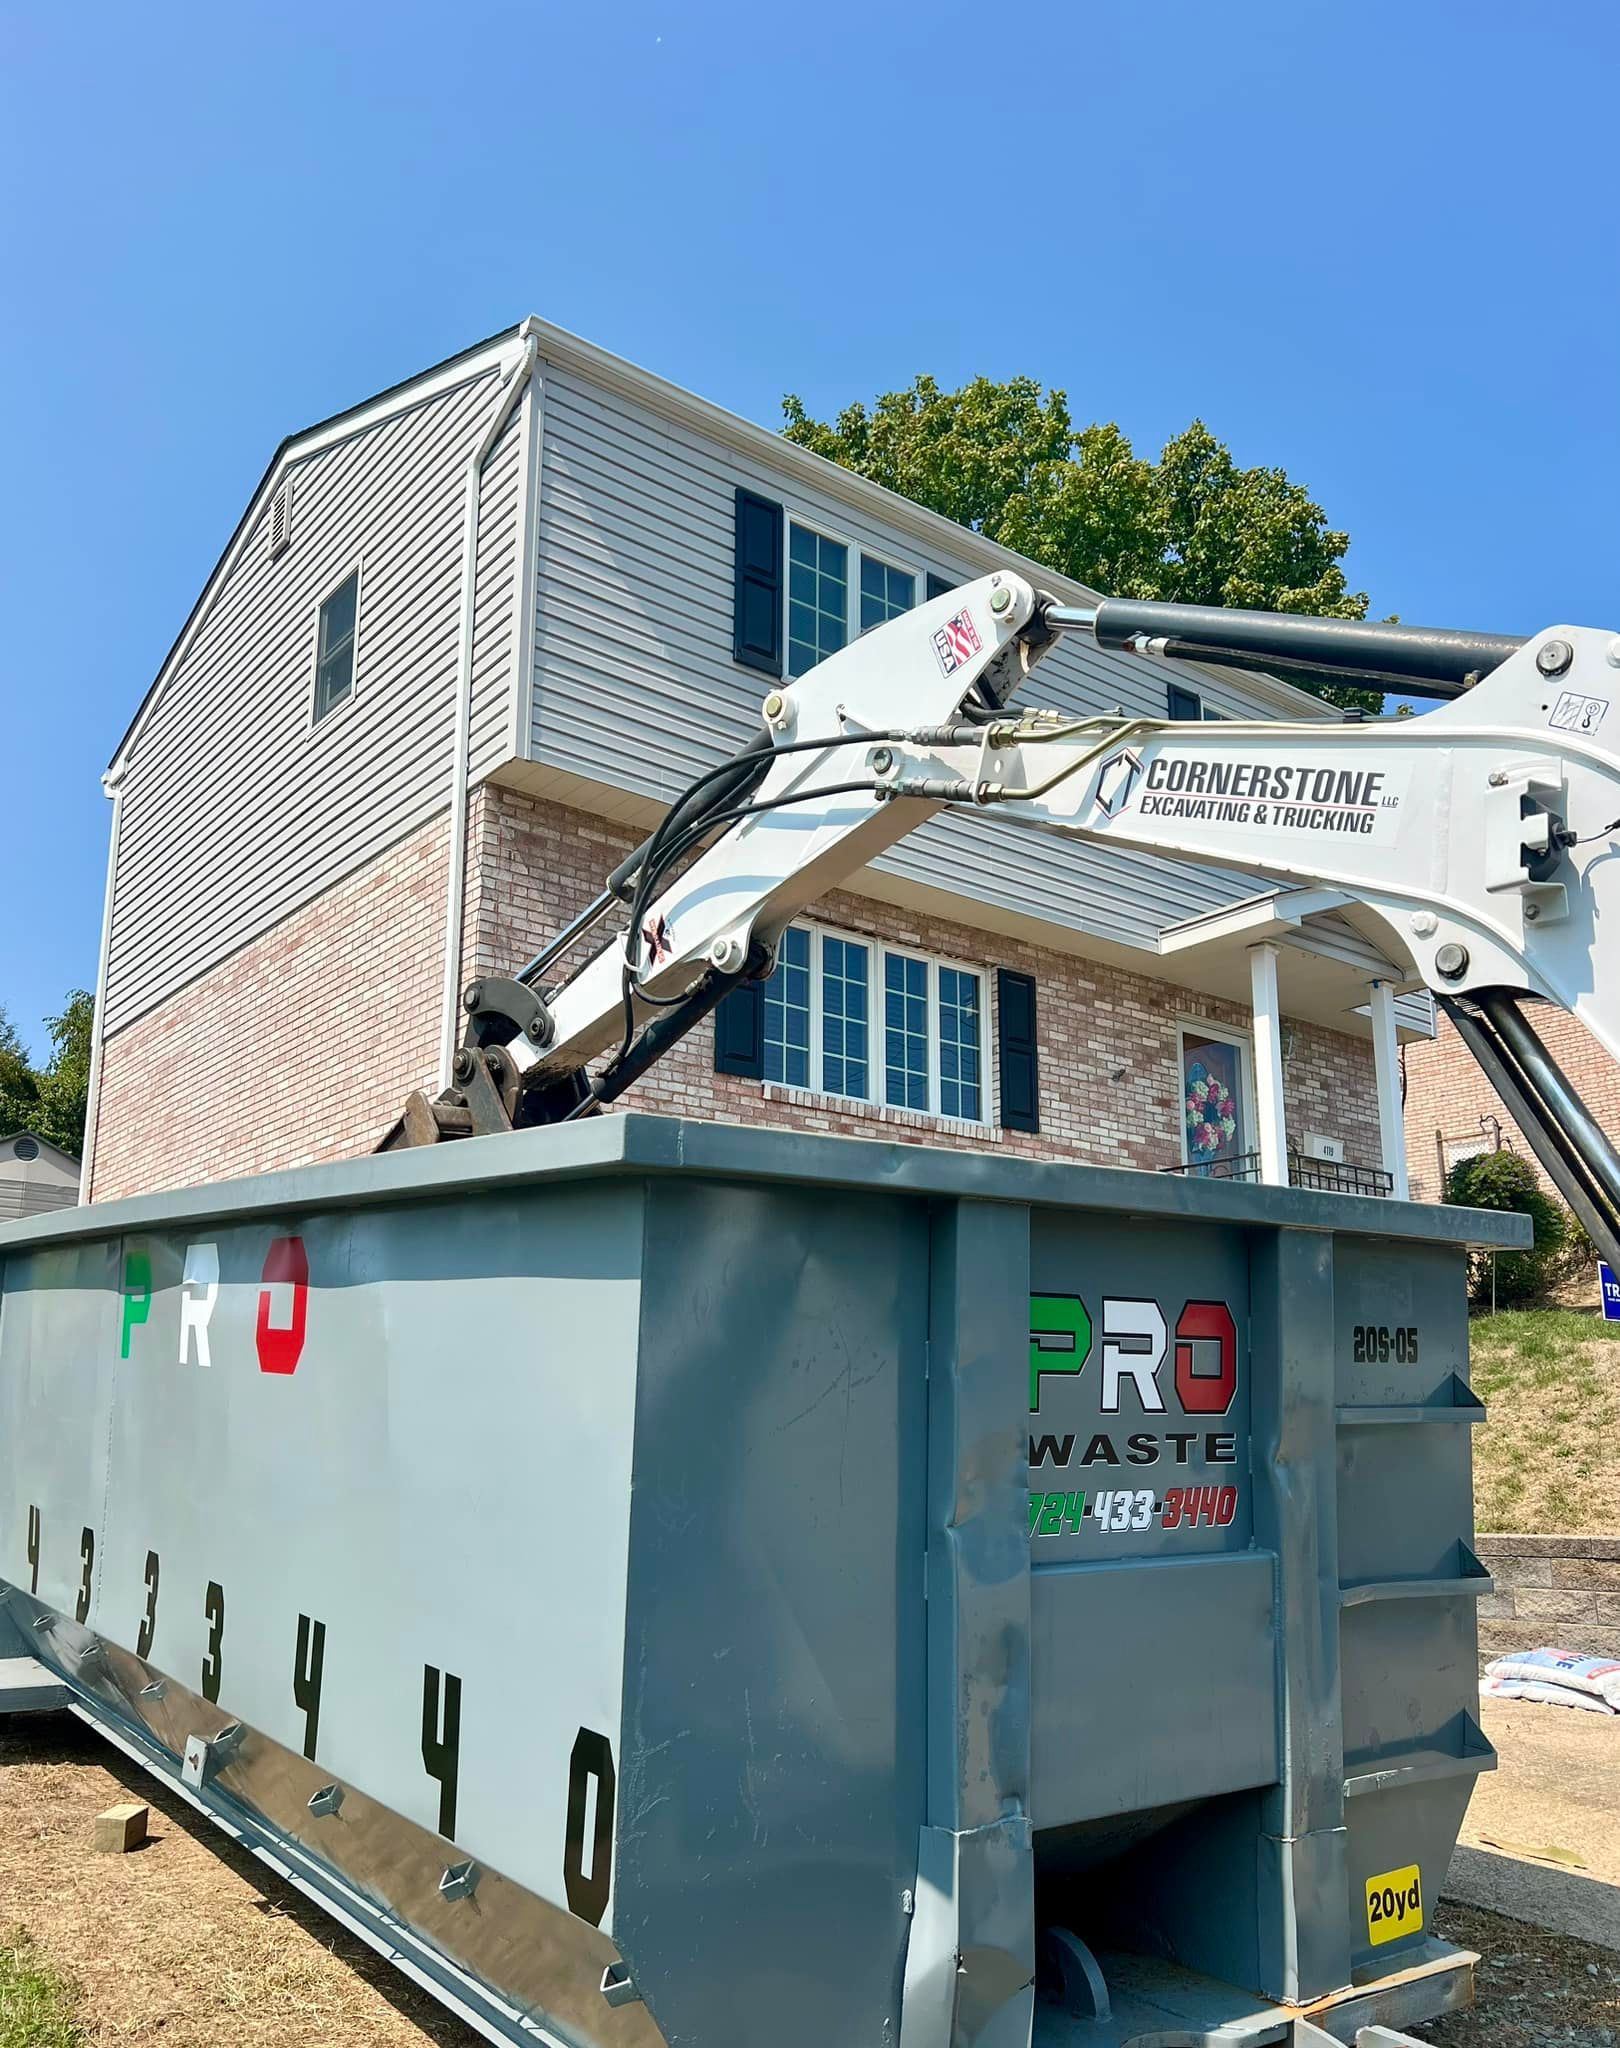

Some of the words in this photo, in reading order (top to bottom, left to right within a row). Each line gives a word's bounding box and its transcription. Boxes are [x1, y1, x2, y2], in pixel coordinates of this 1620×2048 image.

[935, 630, 956, 672] USA
[1146, 759, 1385, 806] CORNERSTONE
[1382, 796, 1399, 807] LLC
[1140, 796, 1251, 823] EXCAVATING
[1253, 803, 1267, 825] &
[1272, 806, 1376, 834] TRUCKING
[121, 1236, 309, 1375] PRO
[1029, 1292, 1238, 1416] PRO
[1353, 1325, 1418, 1364] 20S-05
[1029, 1433, 1237, 1468] WASTE
[1369, 1879, 1420, 1923] 20yd
